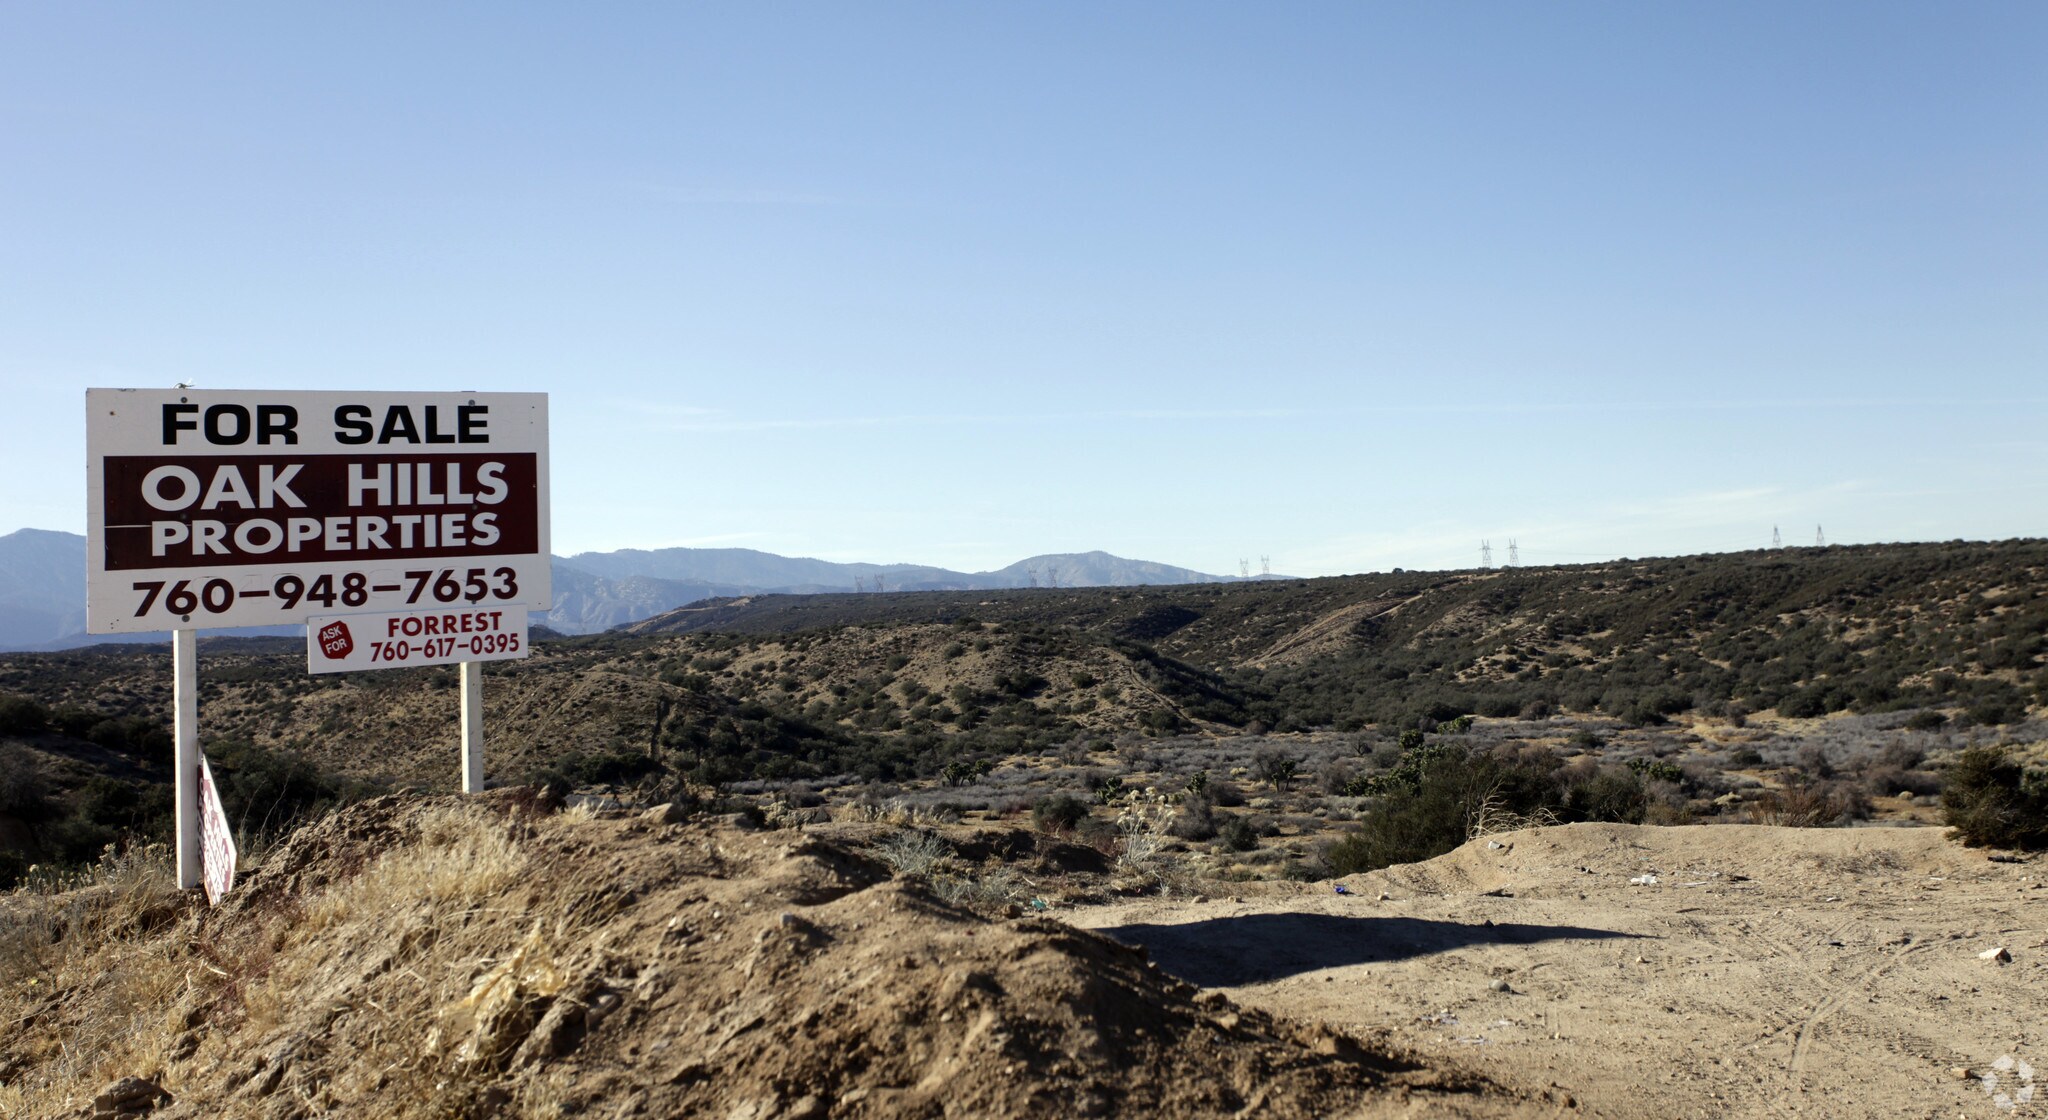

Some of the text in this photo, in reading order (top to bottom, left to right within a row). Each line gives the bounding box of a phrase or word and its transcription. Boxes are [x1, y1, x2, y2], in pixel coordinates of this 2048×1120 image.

[162, 404, 490, 445] FOR SALE
[141, 461, 509, 511] OAK HILLS
[151, 512, 501, 557] PROPERTIES
[133, 566, 519, 617] 760-948-7653
[321, 625, 343, 641] ASK
[388, 611, 503, 637] FORREST
[325, 638, 347, 654] FOR
[370, 633, 519, 662] 760-617-0395
